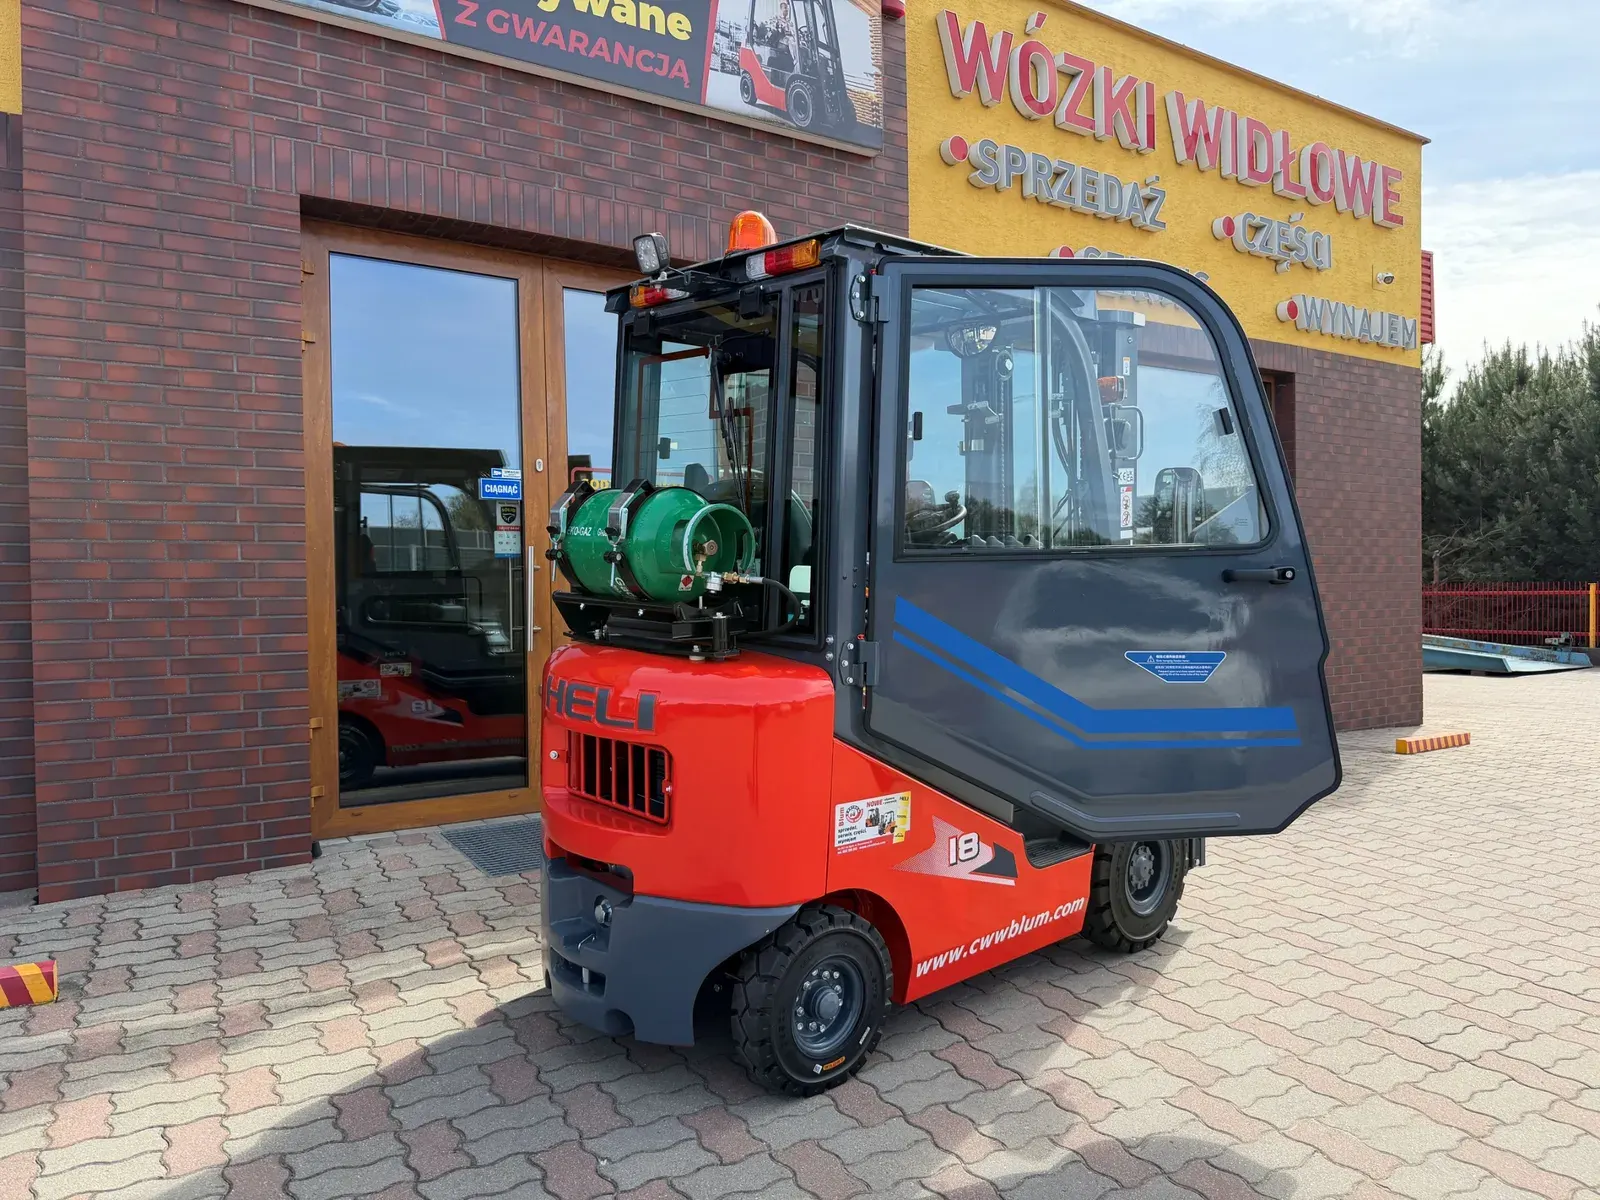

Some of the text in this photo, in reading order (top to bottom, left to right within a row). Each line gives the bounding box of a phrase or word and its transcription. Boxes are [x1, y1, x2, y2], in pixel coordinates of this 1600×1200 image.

[455, 0, 690, 89] Z GWARANCJĄ
[936, 9, 1404, 229] WÓZKI WIDŁOWE
[968, 138, 1167, 232] SPRZEDAŻ
[1232, 212, 1332, 274] CZĘŚCI
[1292, 294, 1417, 350] WYNAJEM
[484, 483, 518, 496] CIĄGNĄĆ
[546, 674, 657, 732] HELI
[866, 799, 883, 808] NOWE
[948, 831, 981, 867] 18
[916, 896, 1085, 978] www.cwwblum.com
